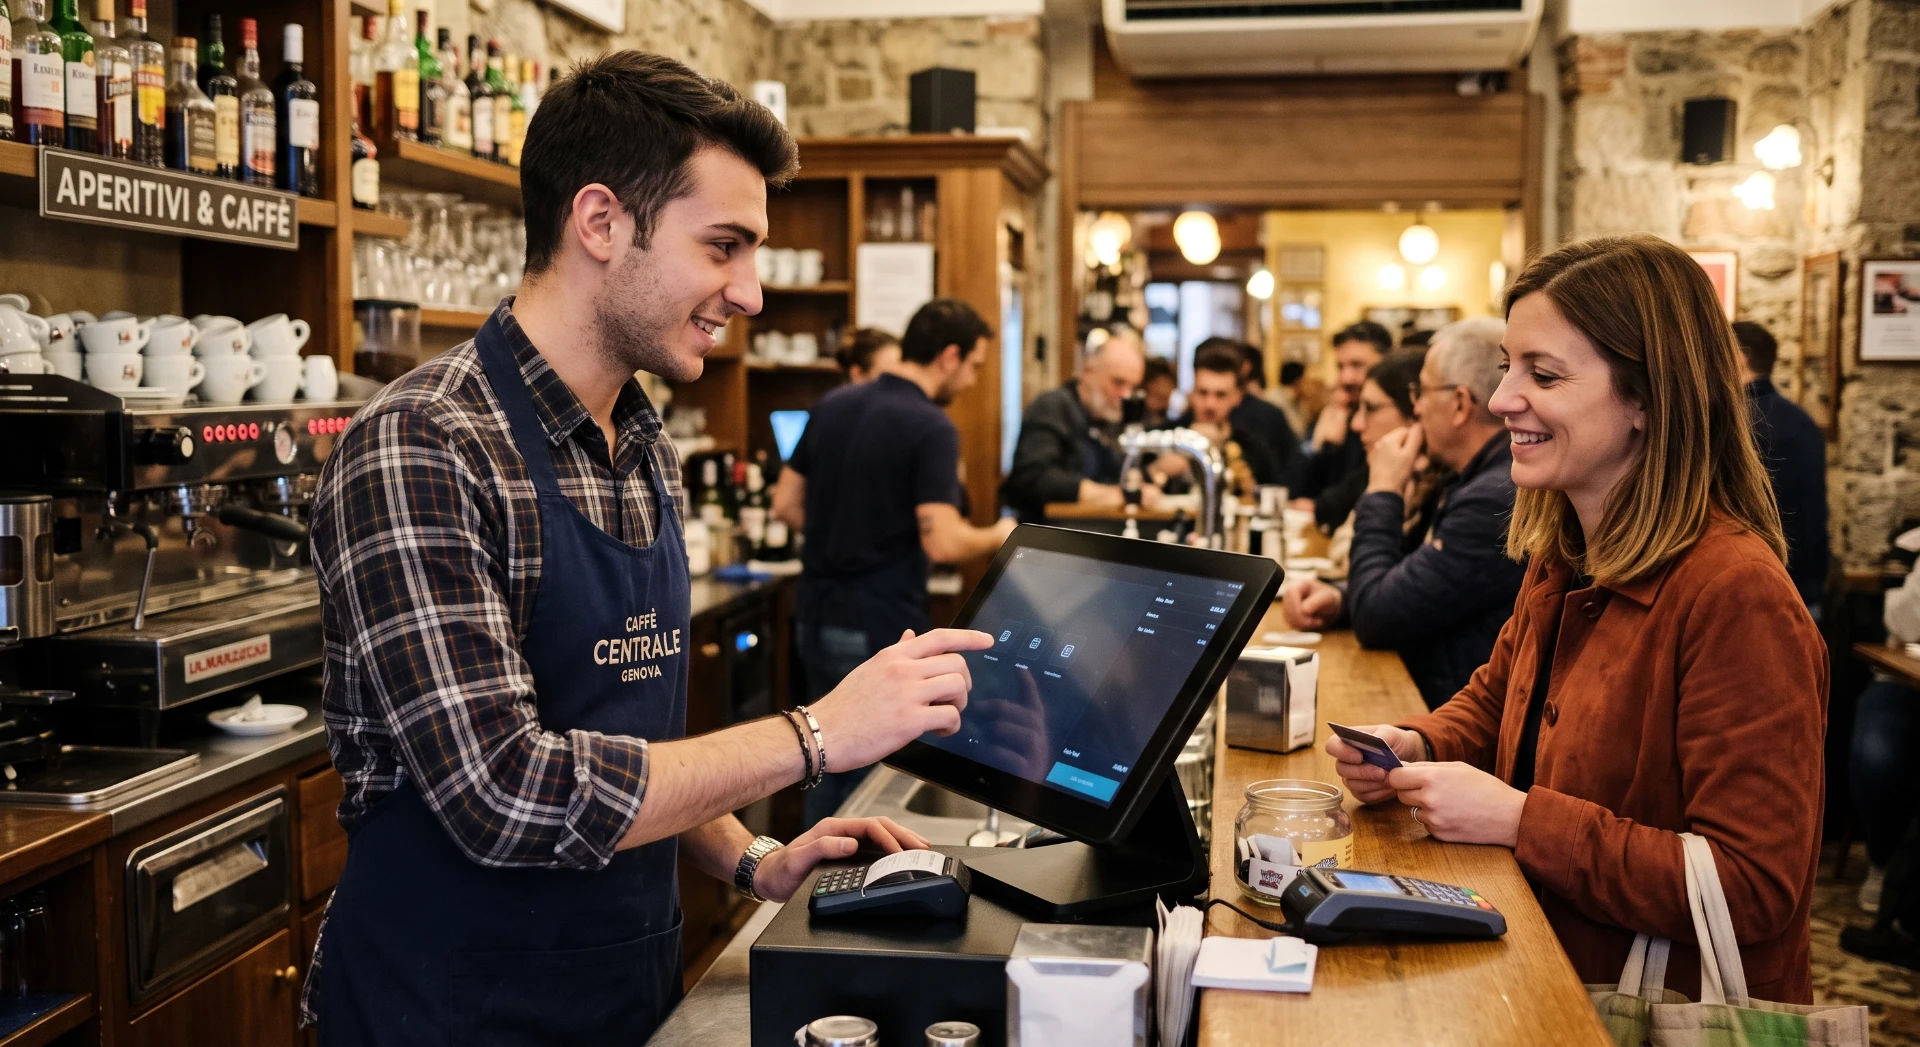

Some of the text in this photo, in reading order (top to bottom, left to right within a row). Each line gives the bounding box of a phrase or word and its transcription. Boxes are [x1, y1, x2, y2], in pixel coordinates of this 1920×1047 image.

[56, 167, 291, 238] APERITIVI & CAFFÈ
[625, 607, 657, 632] CAFFÈ
[593, 628, 681, 666] CENTRALE
[621, 664, 662, 683] GENOVA
